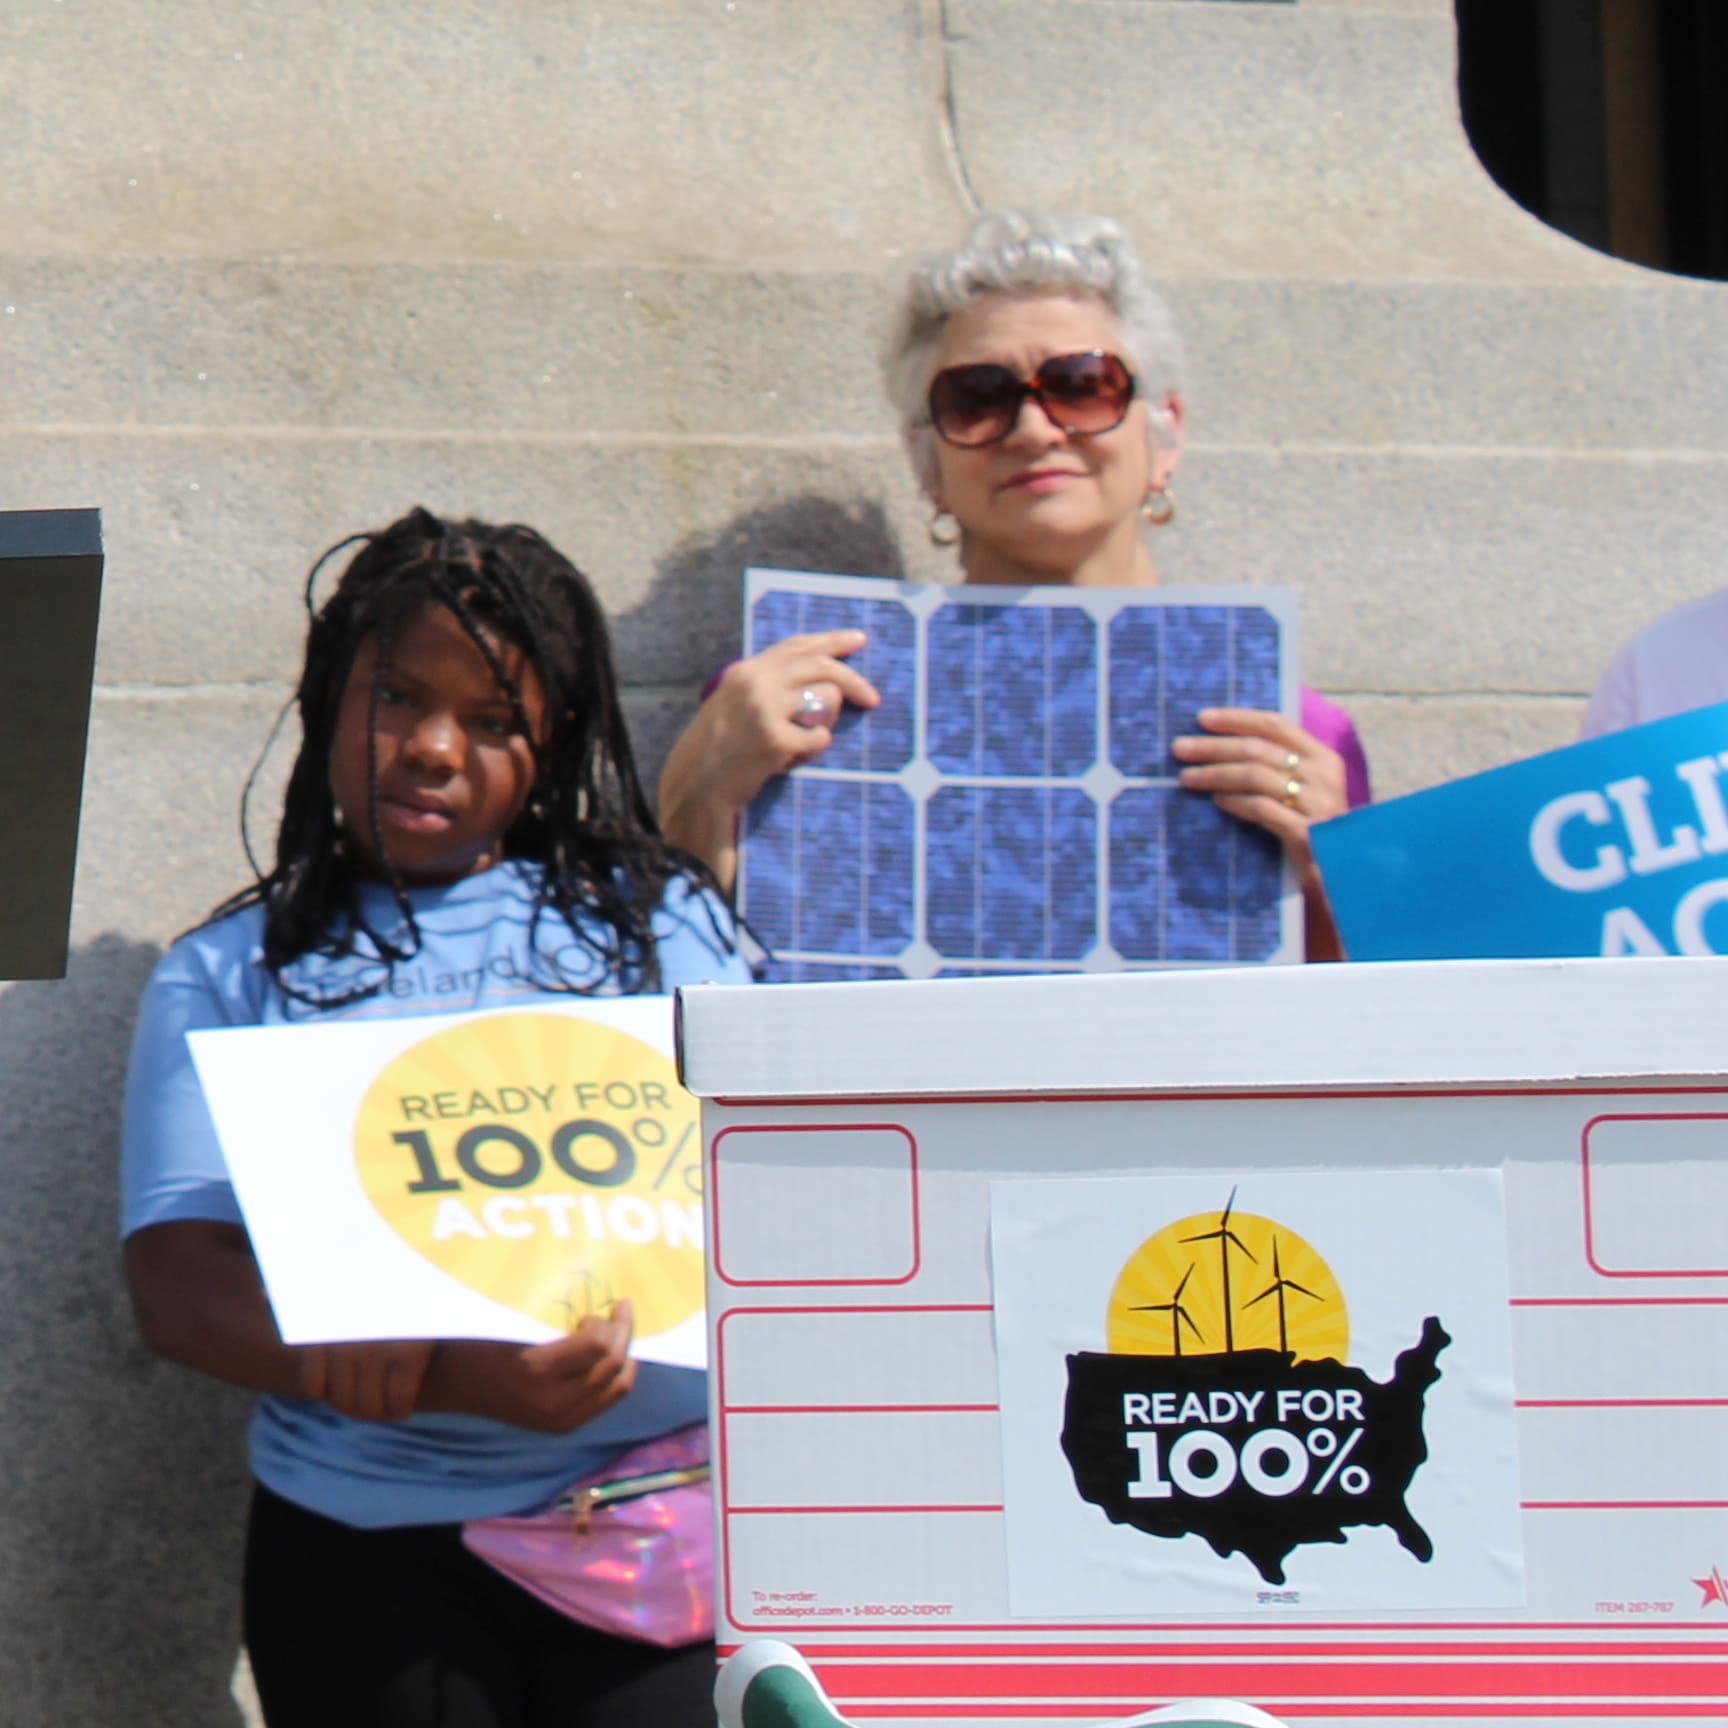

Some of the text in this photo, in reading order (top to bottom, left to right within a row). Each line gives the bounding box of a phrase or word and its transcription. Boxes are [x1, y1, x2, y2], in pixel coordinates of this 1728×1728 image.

[1529, 750, 1728, 893] CLI
[401, 1081, 671, 1121] READY FOR
[390, 1117, 703, 1195] 100%
[433, 1193, 704, 1249] ACTION
[1123, 1389, 1366, 1425] READY FOR
[1126, 1427, 1371, 1498] 100%
